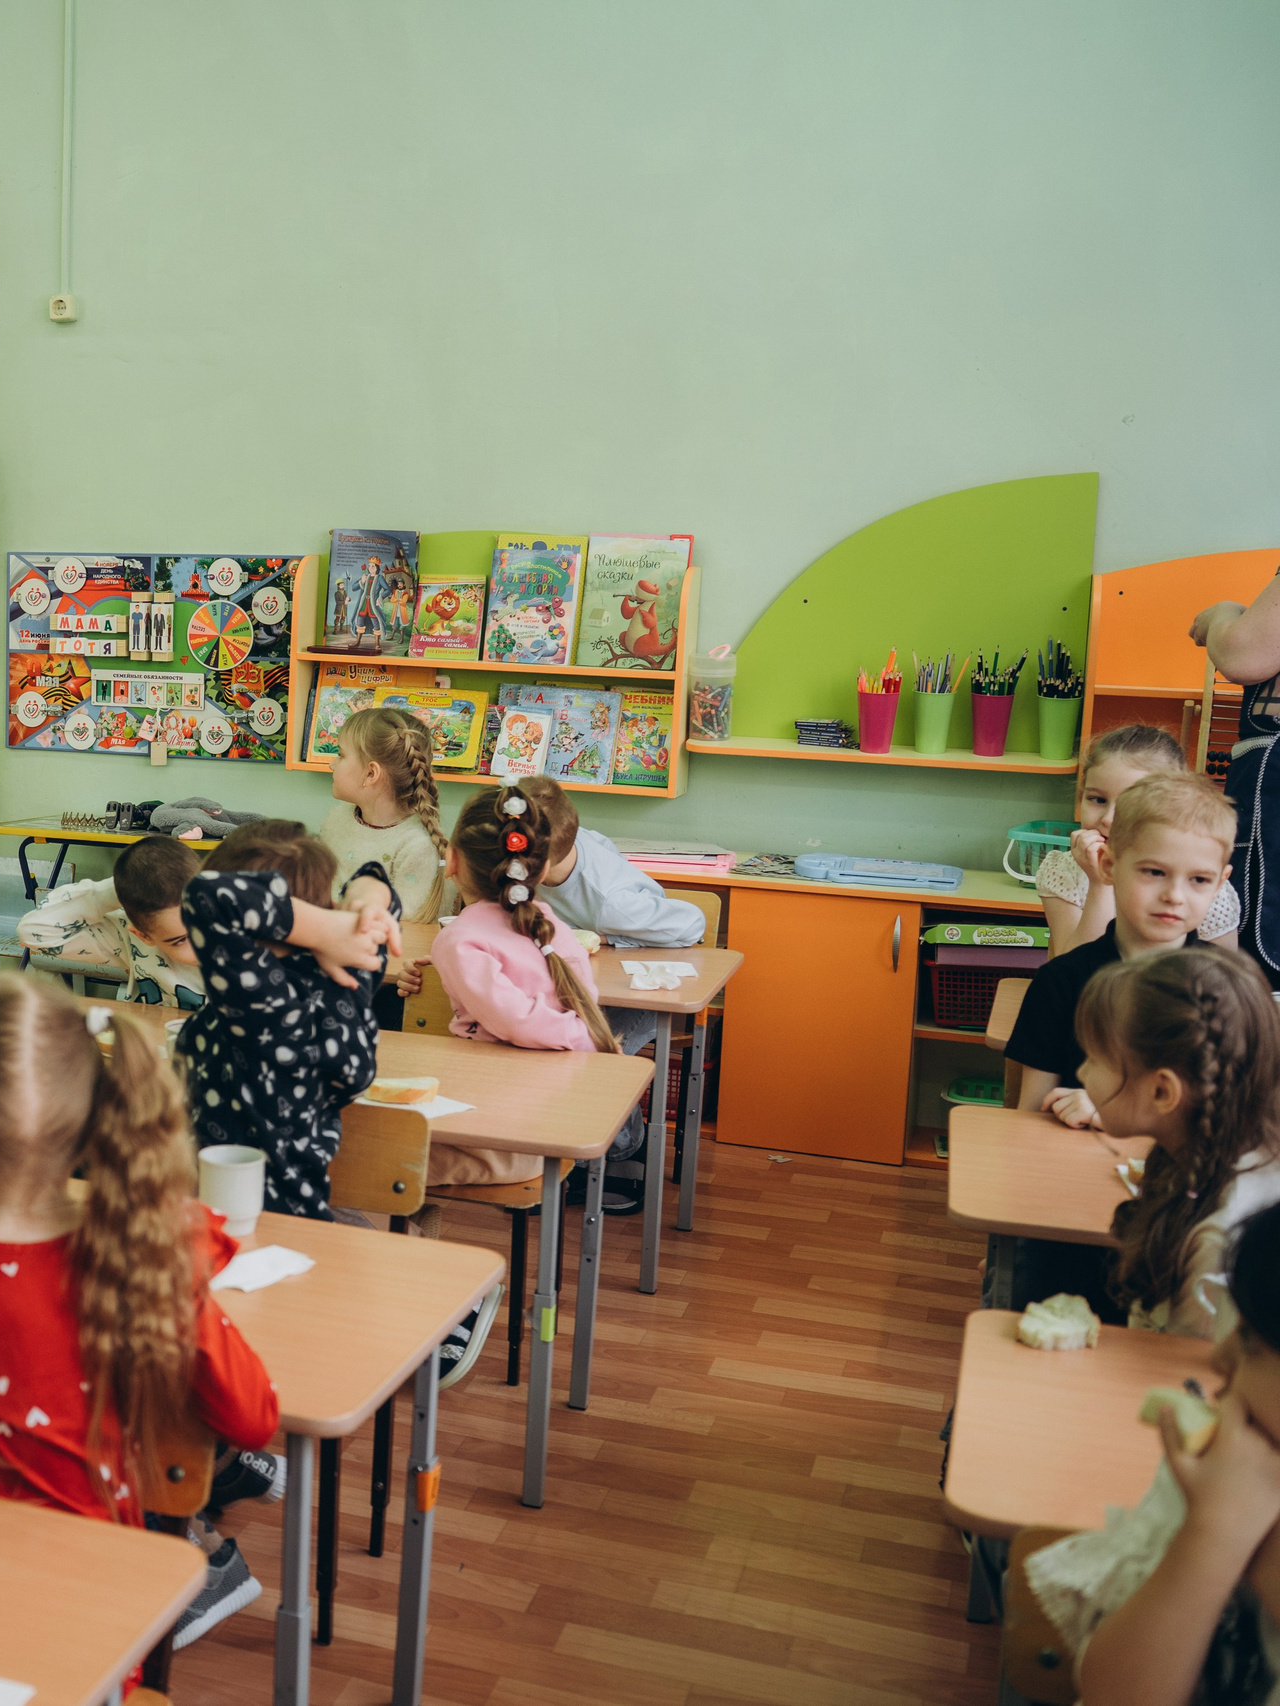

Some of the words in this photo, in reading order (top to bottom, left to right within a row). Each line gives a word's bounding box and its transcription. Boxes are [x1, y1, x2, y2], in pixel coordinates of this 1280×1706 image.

[594, 554, 661, 569] Плюшевые
[502, 571, 554, 584] ВОЛШЕБНАЯ
[597, 571, 634, 583] сказки
[520, 584, 558, 595] ИСТОРИЯ
[60, 617, 112, 631] МАМА
[20, 630, 30, 638] 12
[60, 640, 111, 655] ТОТЯ
[237, 670, 258, 683] 23
[349, 665, 375, 679] Учим
[36, 676, 60, 687] Мая
[360, 675, 392, 684] цифры
[624, 694, 674, 705] ЧЕБНИК
[167, 735, 195, 748] Марта
[613, 772, 632, 780] ЗБУКА
[635, 773, 666, 782] ИГРУШЕК
[977, 927, 1017, 937] Новая
[980, 936, 1028, 944] мозаика
